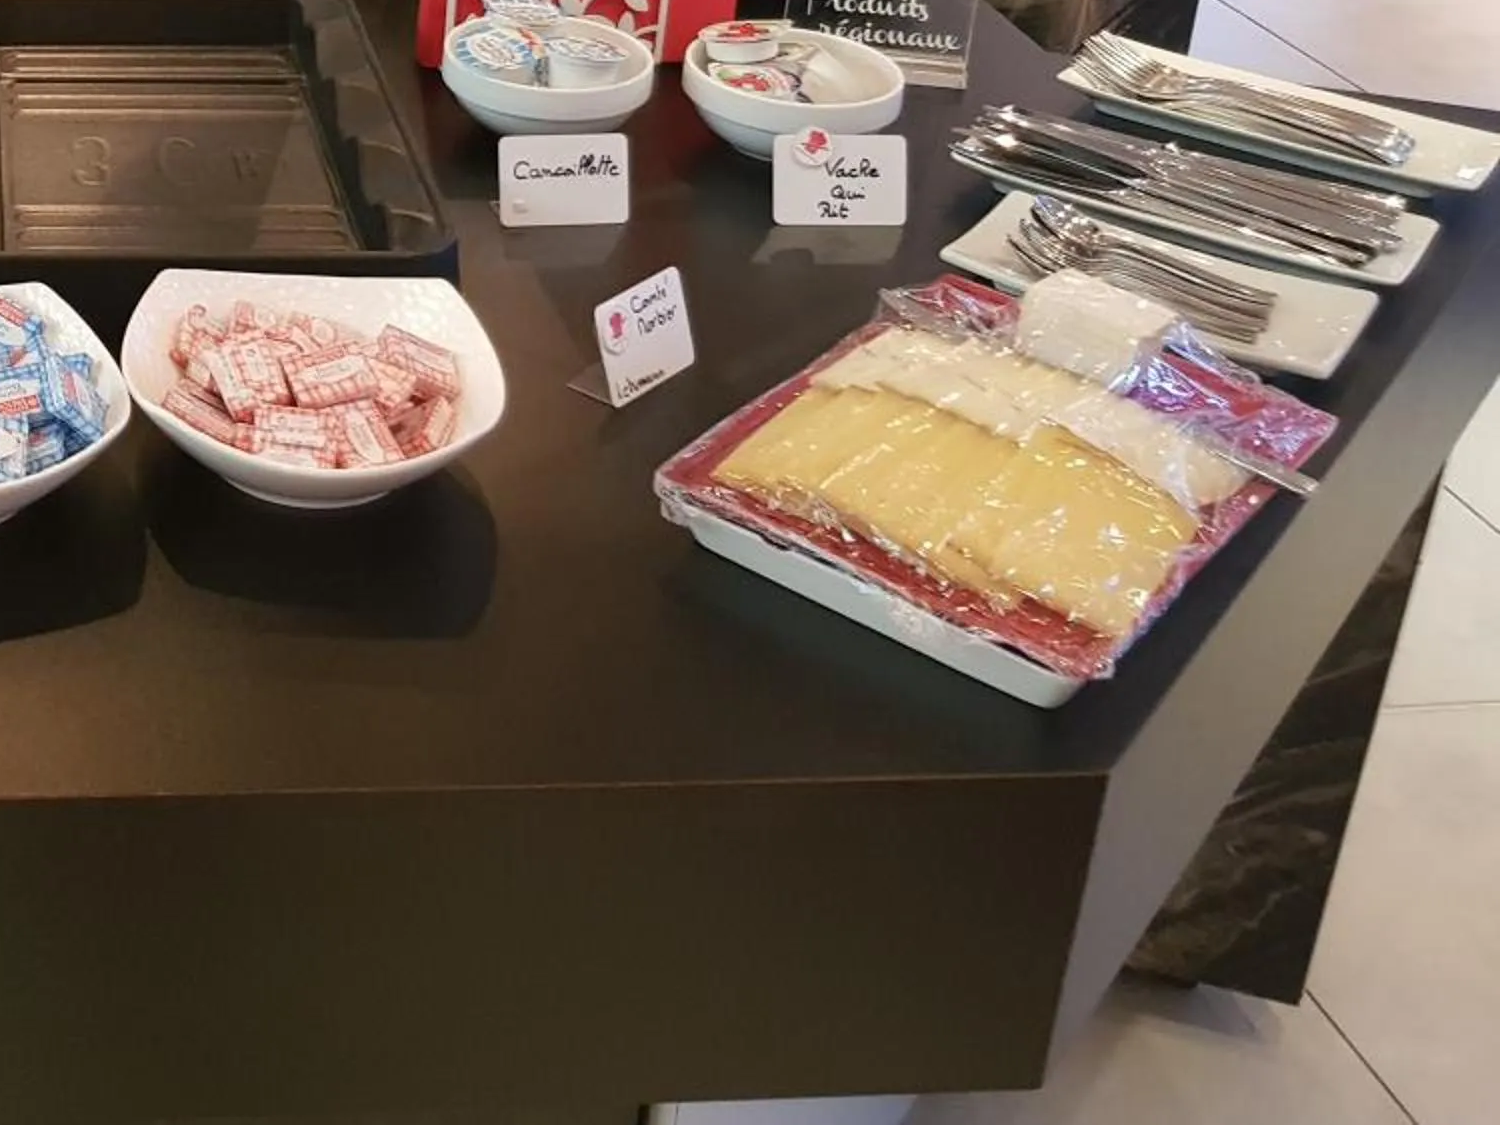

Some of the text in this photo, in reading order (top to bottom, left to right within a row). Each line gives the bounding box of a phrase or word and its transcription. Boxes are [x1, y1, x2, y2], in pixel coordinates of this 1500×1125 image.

[824, 156, 881, 178] Vache
[830, 184, 866, 200] Qui
[817, 201, 850, 219] Rit
